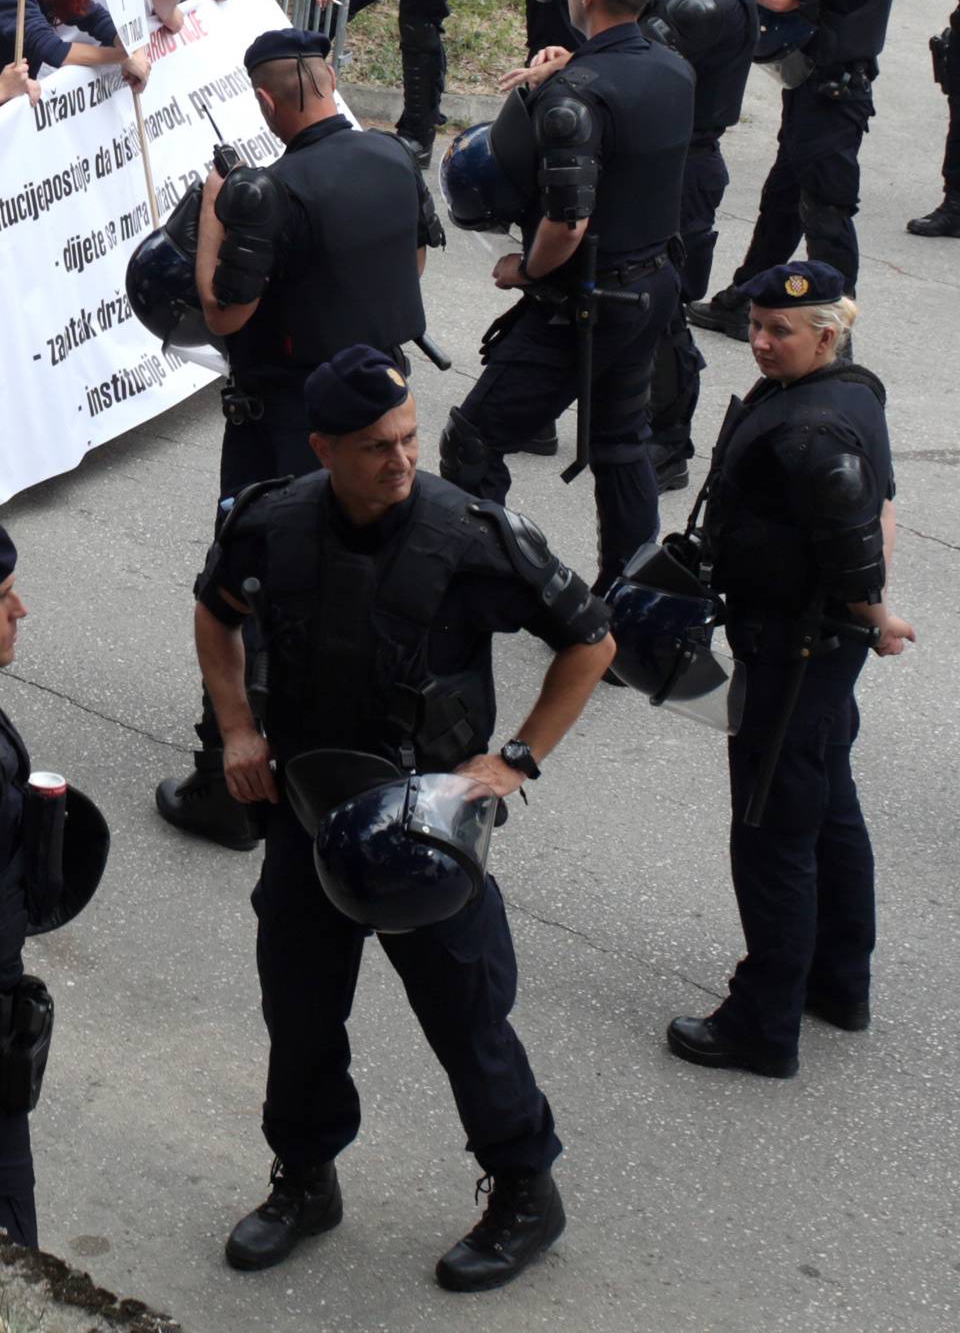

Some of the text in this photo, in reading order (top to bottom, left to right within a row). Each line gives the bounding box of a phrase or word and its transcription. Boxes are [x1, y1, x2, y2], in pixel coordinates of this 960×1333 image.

[33, 85, 86, 132] Državo
[95, 145, 112, 179] da
[144, 95, 192, 143] narod,
[63, 227, 107, 273] dijete
[120, 201, 151, 242] mora
[85, 353, 167, 418] institucije
